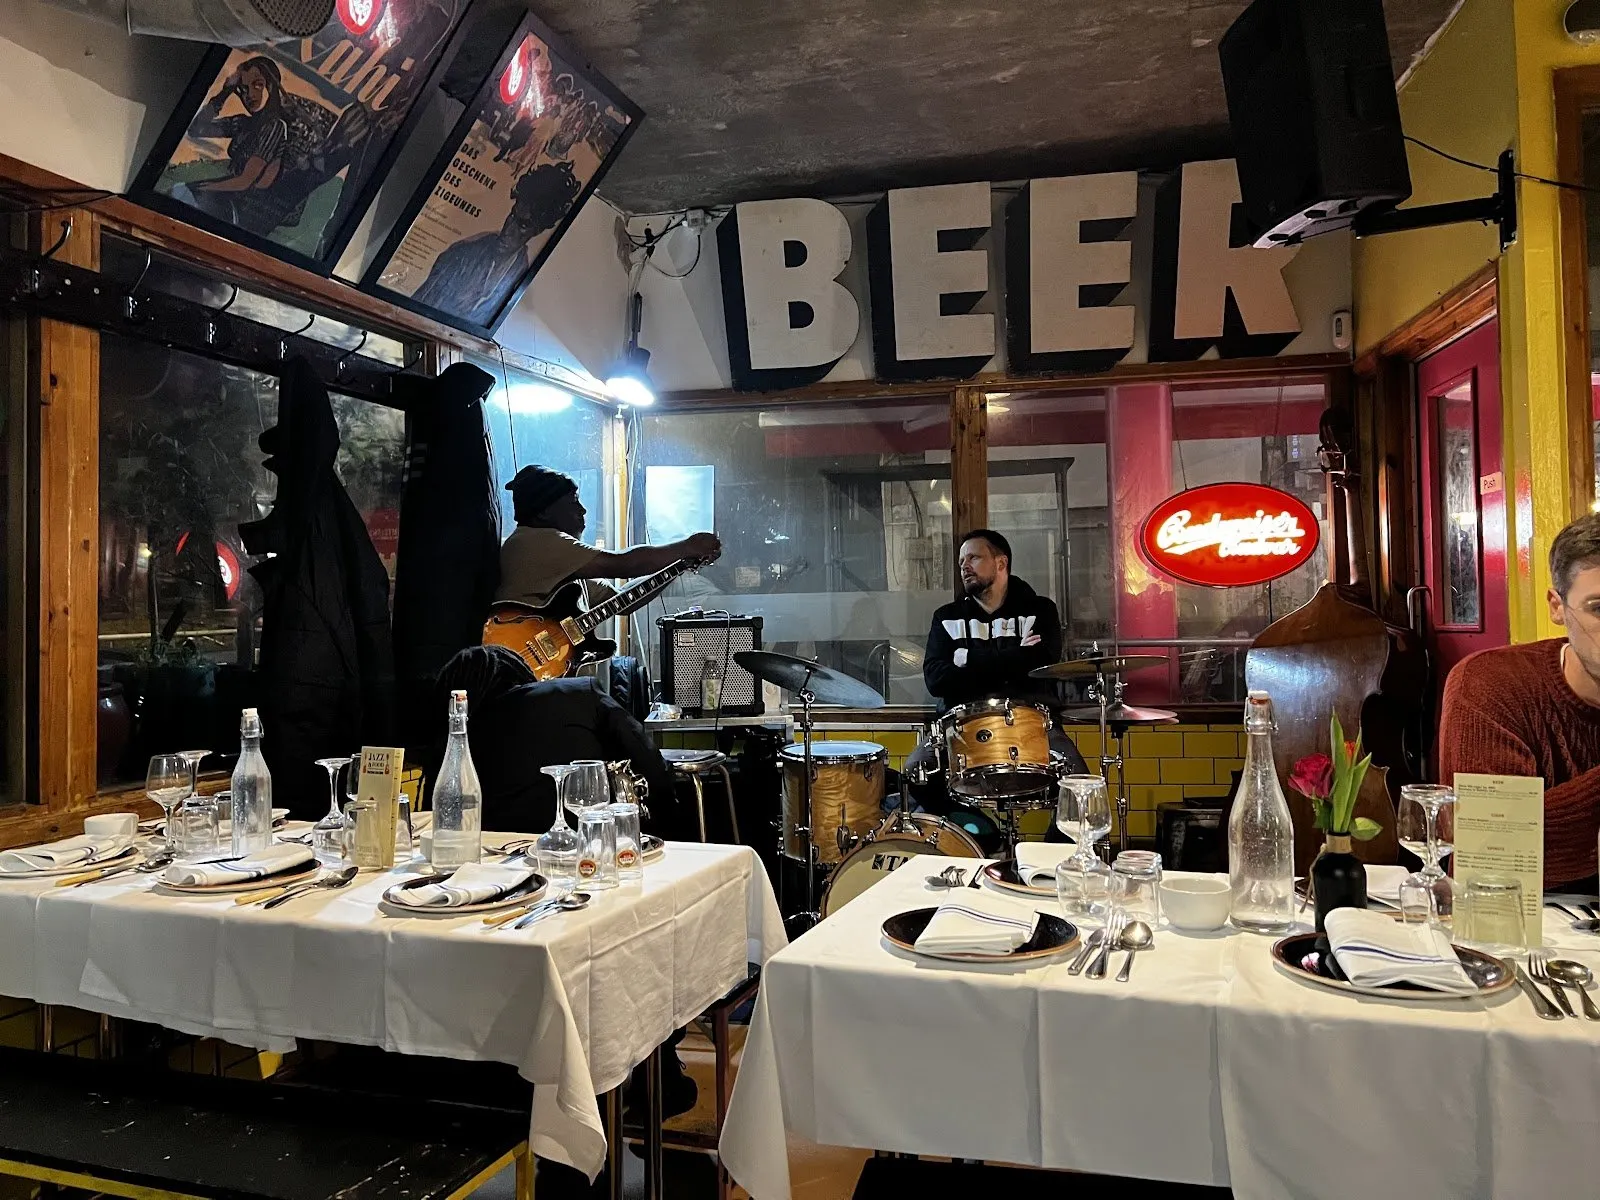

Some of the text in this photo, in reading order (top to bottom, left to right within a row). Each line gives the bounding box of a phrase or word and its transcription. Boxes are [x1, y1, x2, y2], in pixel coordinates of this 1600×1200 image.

[461, 143, 479, 160] DAS
[443, 172, 462, 188] DES
[453, 158, 497, 190] GESCHENK
[434, 186, 482, 218] ZIGEUNERS
[728, 158, 1302, 377] BEER
